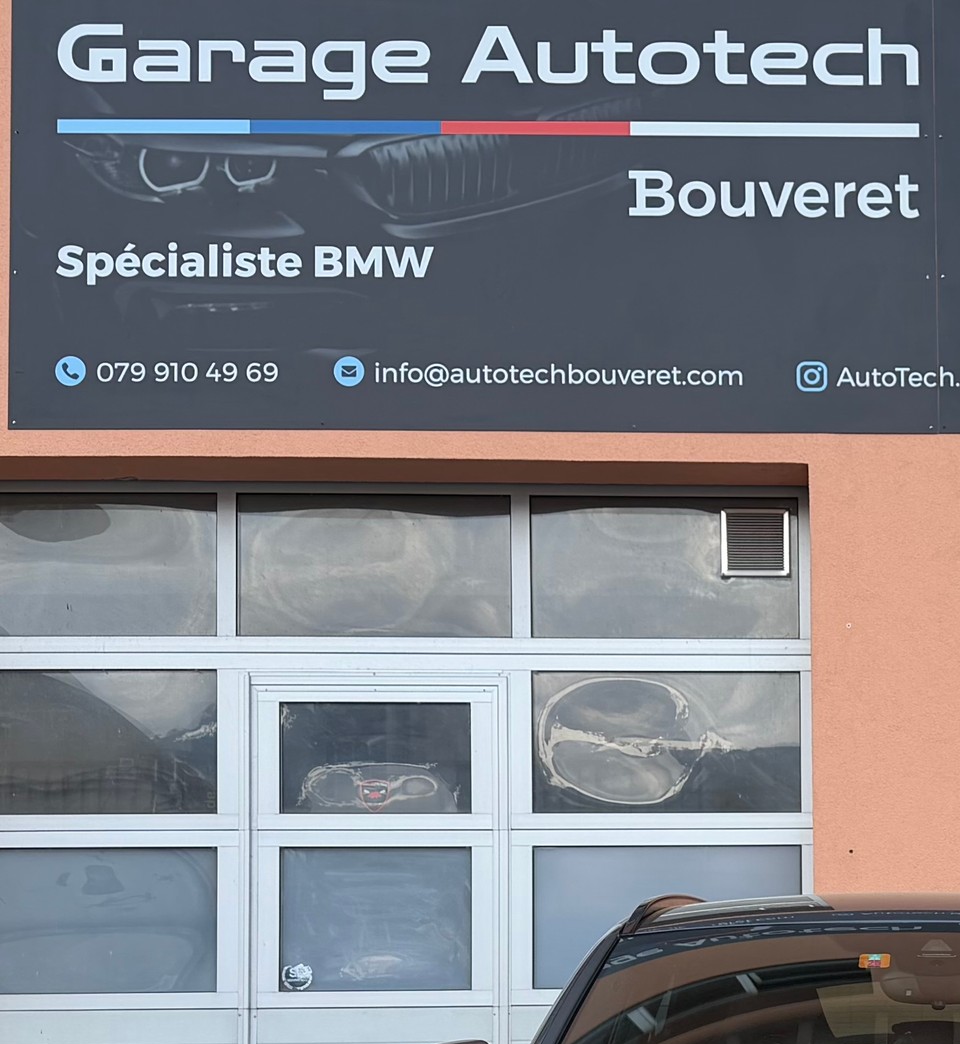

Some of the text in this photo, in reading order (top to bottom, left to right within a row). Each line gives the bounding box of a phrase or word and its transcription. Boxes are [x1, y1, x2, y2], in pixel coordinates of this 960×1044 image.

[58, 24, 919, 100] Garage Autotech
[628, 170, 920, 219] Bouveret
[55, 242, 435, 286] Spécialiste BMW
[96, 362, 279, 383] 079 910 49 69
[374, 361, 743, 388] info@autotechbouveret.com
